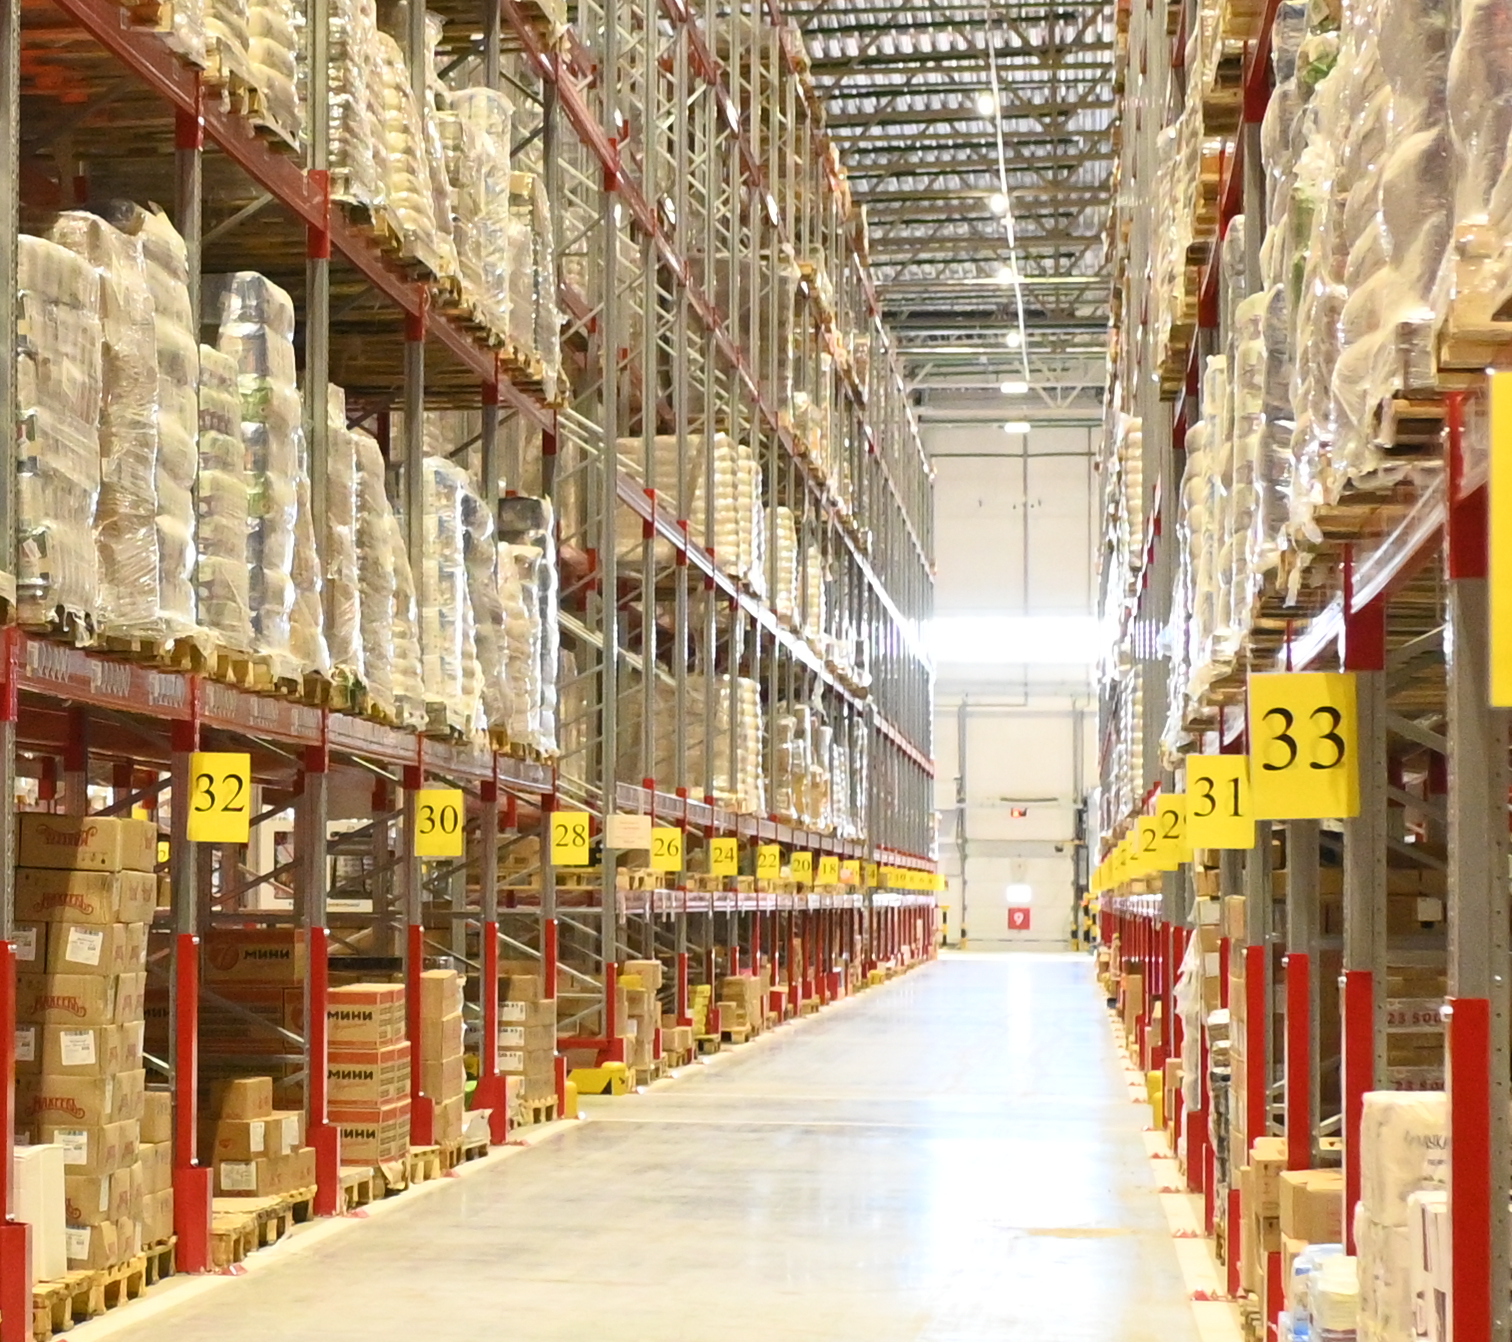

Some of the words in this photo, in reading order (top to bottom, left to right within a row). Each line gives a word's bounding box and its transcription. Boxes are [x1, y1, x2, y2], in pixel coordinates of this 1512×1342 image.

[1261, 706, 1346, 772] 33
[193, 772, 245, 813] 32
[1193, 777, 1243, 817] 31
[418, 804, 459, 834] 30
[1162, 810, 1187, 839] 2
[556, 824, 586, 847] 28
[1143, 829, 1157, 852] 2
[653, 838, 679, 856] 26
[713, 847, 735, 863] 24
[758, 853, 777, 868] 22
[792, 858, 811, 872] 20
[822, 863, 836, 875] 18
[1013, 911, 1024, 926] 9
[1388, 1012, 1406, 1025] 23
[340, 1129, 376, 1140] ИНИ
